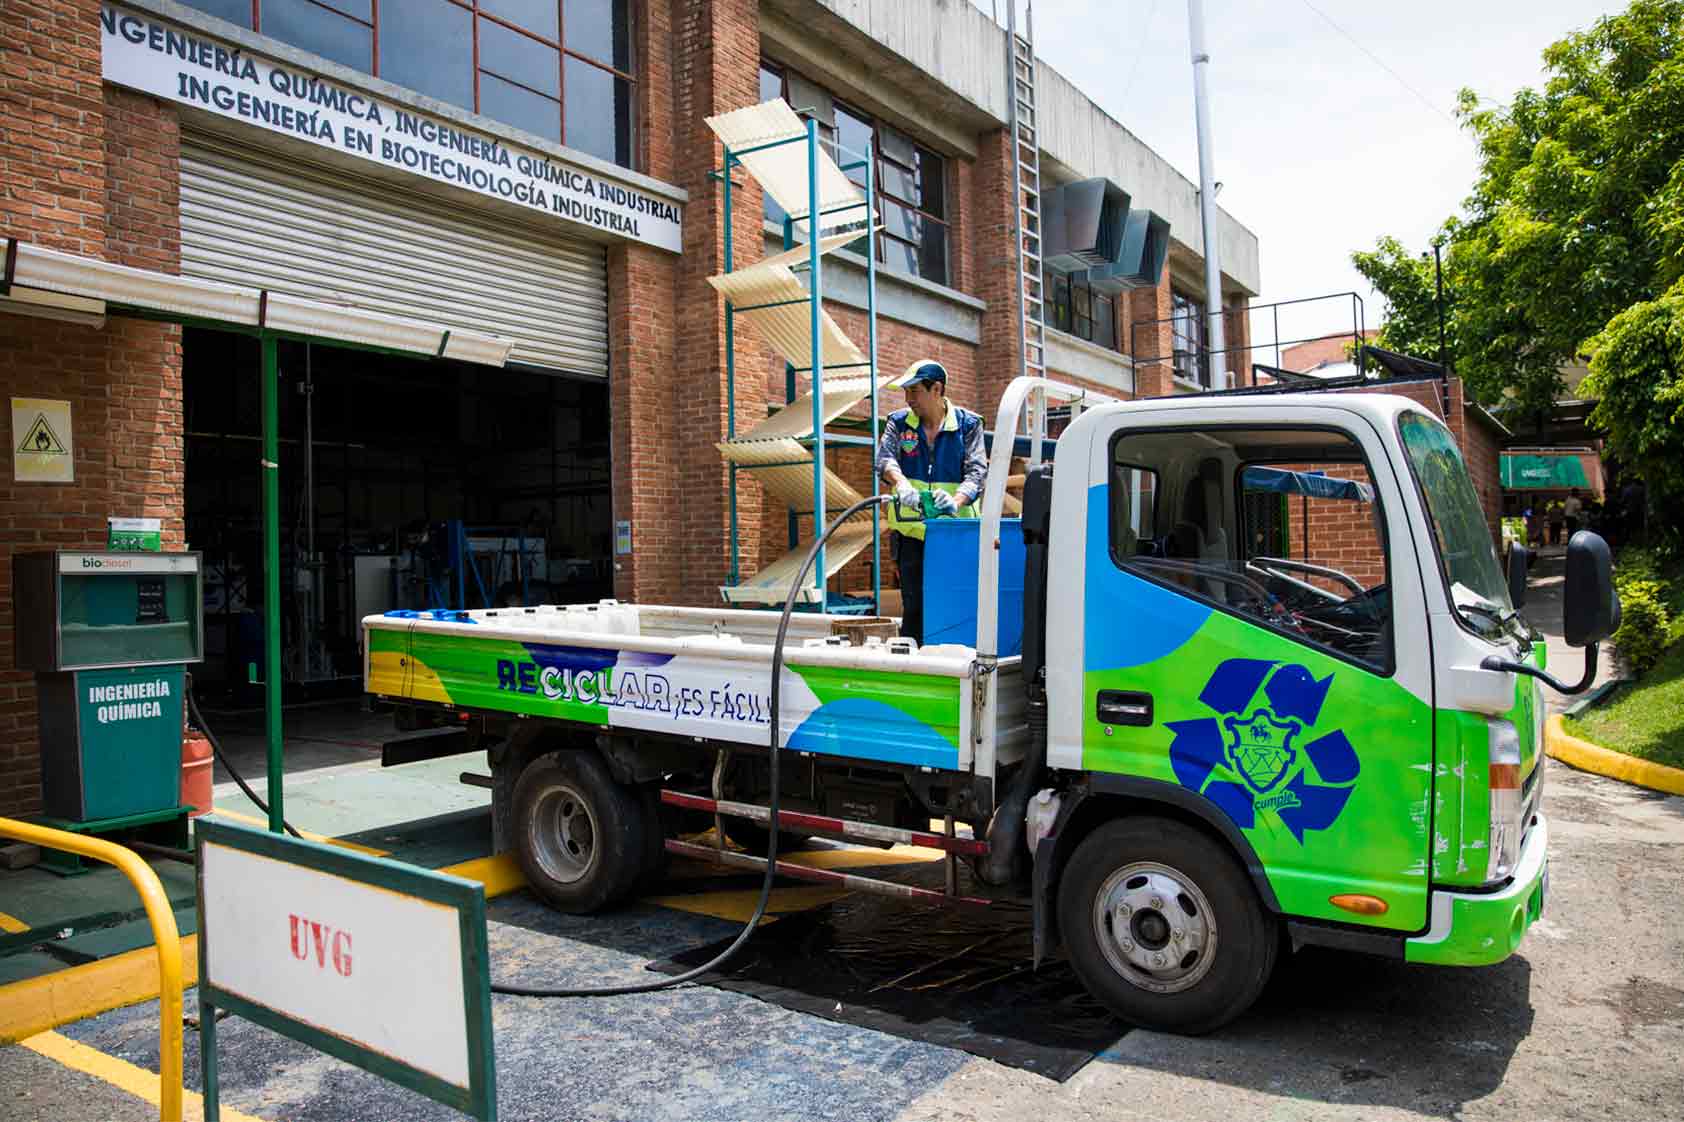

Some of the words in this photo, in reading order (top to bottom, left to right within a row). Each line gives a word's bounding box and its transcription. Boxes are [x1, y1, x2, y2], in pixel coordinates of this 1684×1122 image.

[100, 7, 260, 85] NGENIERÍA
[396, 111, 511, 169] INGENIERÍA
[517, 154, 595, 196] QUÍMICA
[599, 182, 680, 225] INDUSTRIAL
[178, 71, 336, 143] INGENIERÍA
[344, 126, 373, 154] EN
[381, 138, 548, 209] BIOTECNOLOGÍA
[552, 195, 641, 237] INDUSTRIAL
[89, 679, 171, 703] INGENIERÍA
[98, 701, 161, 724] QUÍMICA
[496, 660, 671, 712] RECICLAR
[674, 687, 704, 721] ¡ES
[288, 914, 353, 977] UVG
